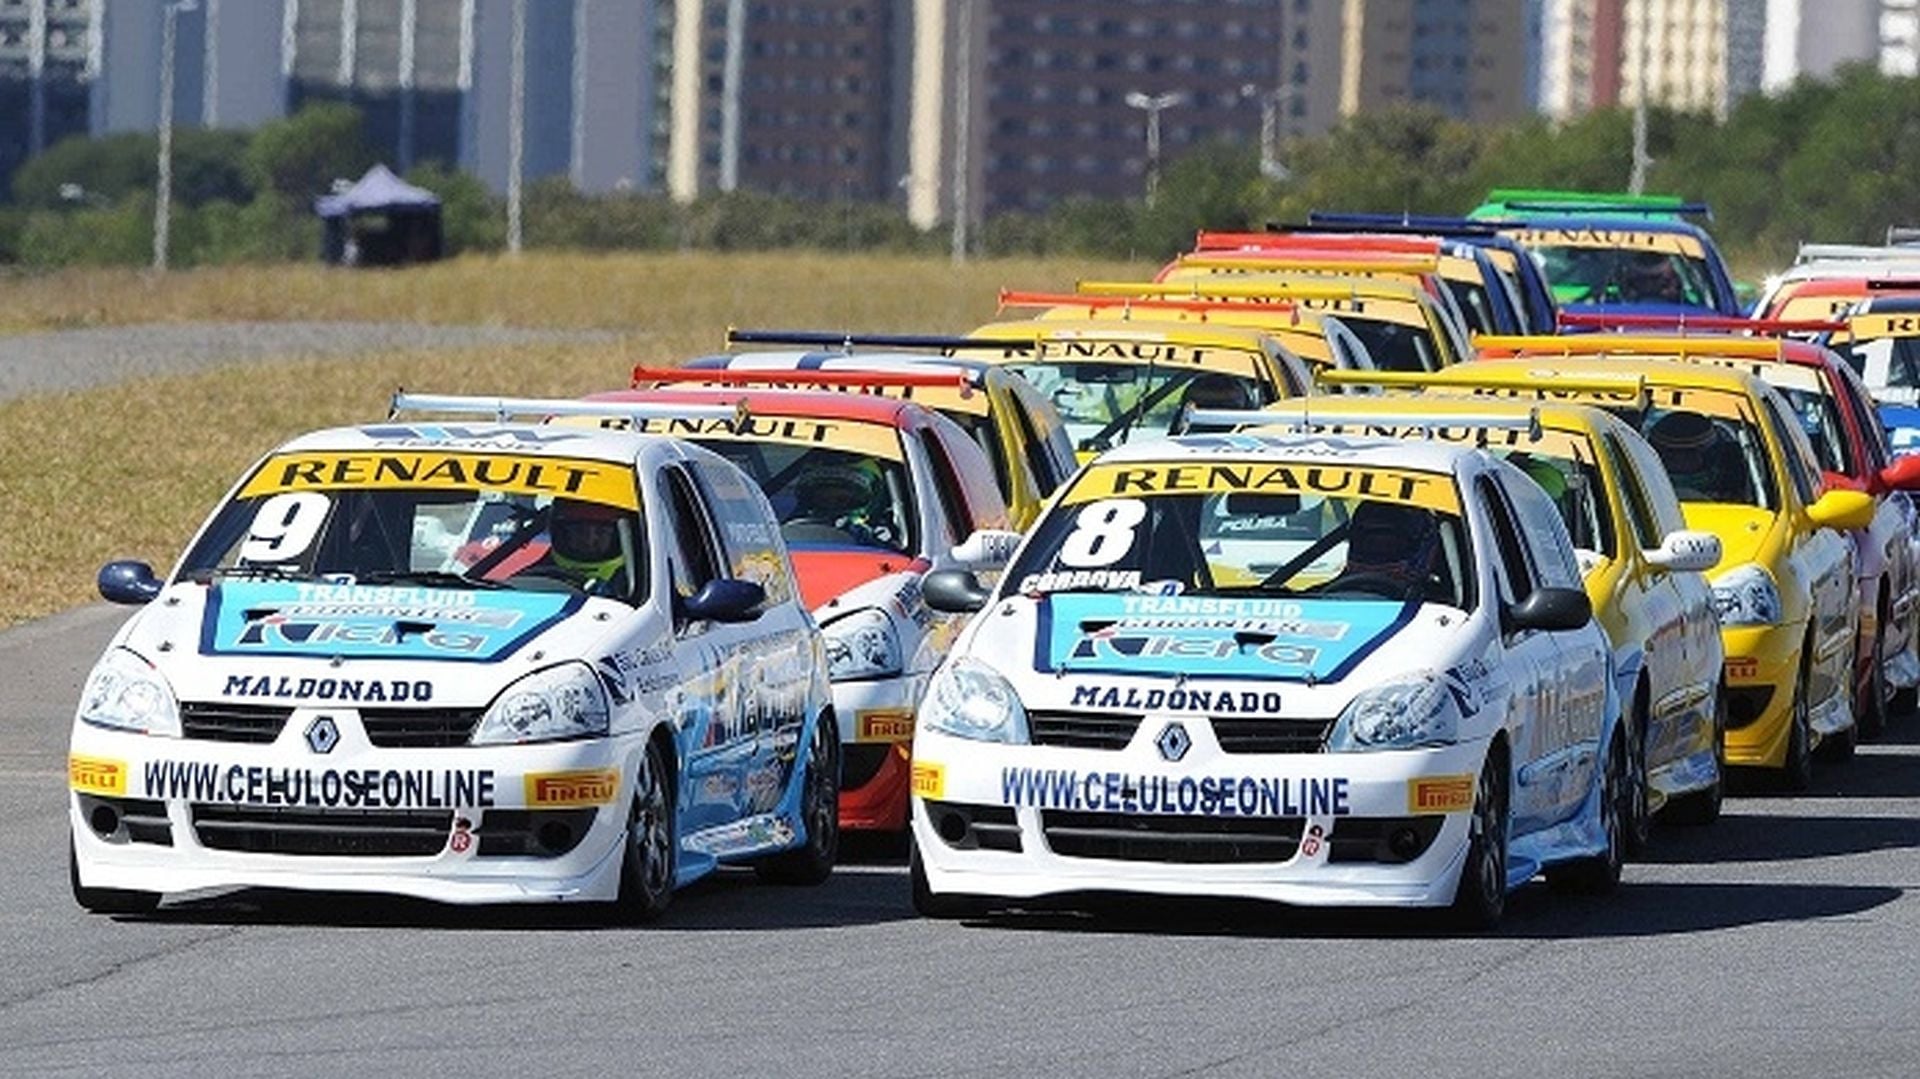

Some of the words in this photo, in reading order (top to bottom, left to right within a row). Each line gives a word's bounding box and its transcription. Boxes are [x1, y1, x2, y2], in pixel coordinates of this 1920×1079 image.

[1003, 341, 1213, 364] RENAULT
[597, 416, 839, 441] RENAULT
[279, 458, 600, 493] RENAULT
[1112, 466, 1431, 502] RENAULT
[241, 491, 331, 563] 9
[1060, 499, 1147, 567] 8
[297, 583, 477, 606] TRANSFLUID
[1122, 598, 1304, 618] TRANSFLUID
[223, 674, 433, 702] MALDONADO
[1070, 685, 1282, 713] MALDONADO
[144, 759, 495, 808] WWW.CELULOSEONLINE
[536, 775, 616, 802] PIRELLI
[1002, 767, 1350, 817] WWW.CELULOSEONLINE
